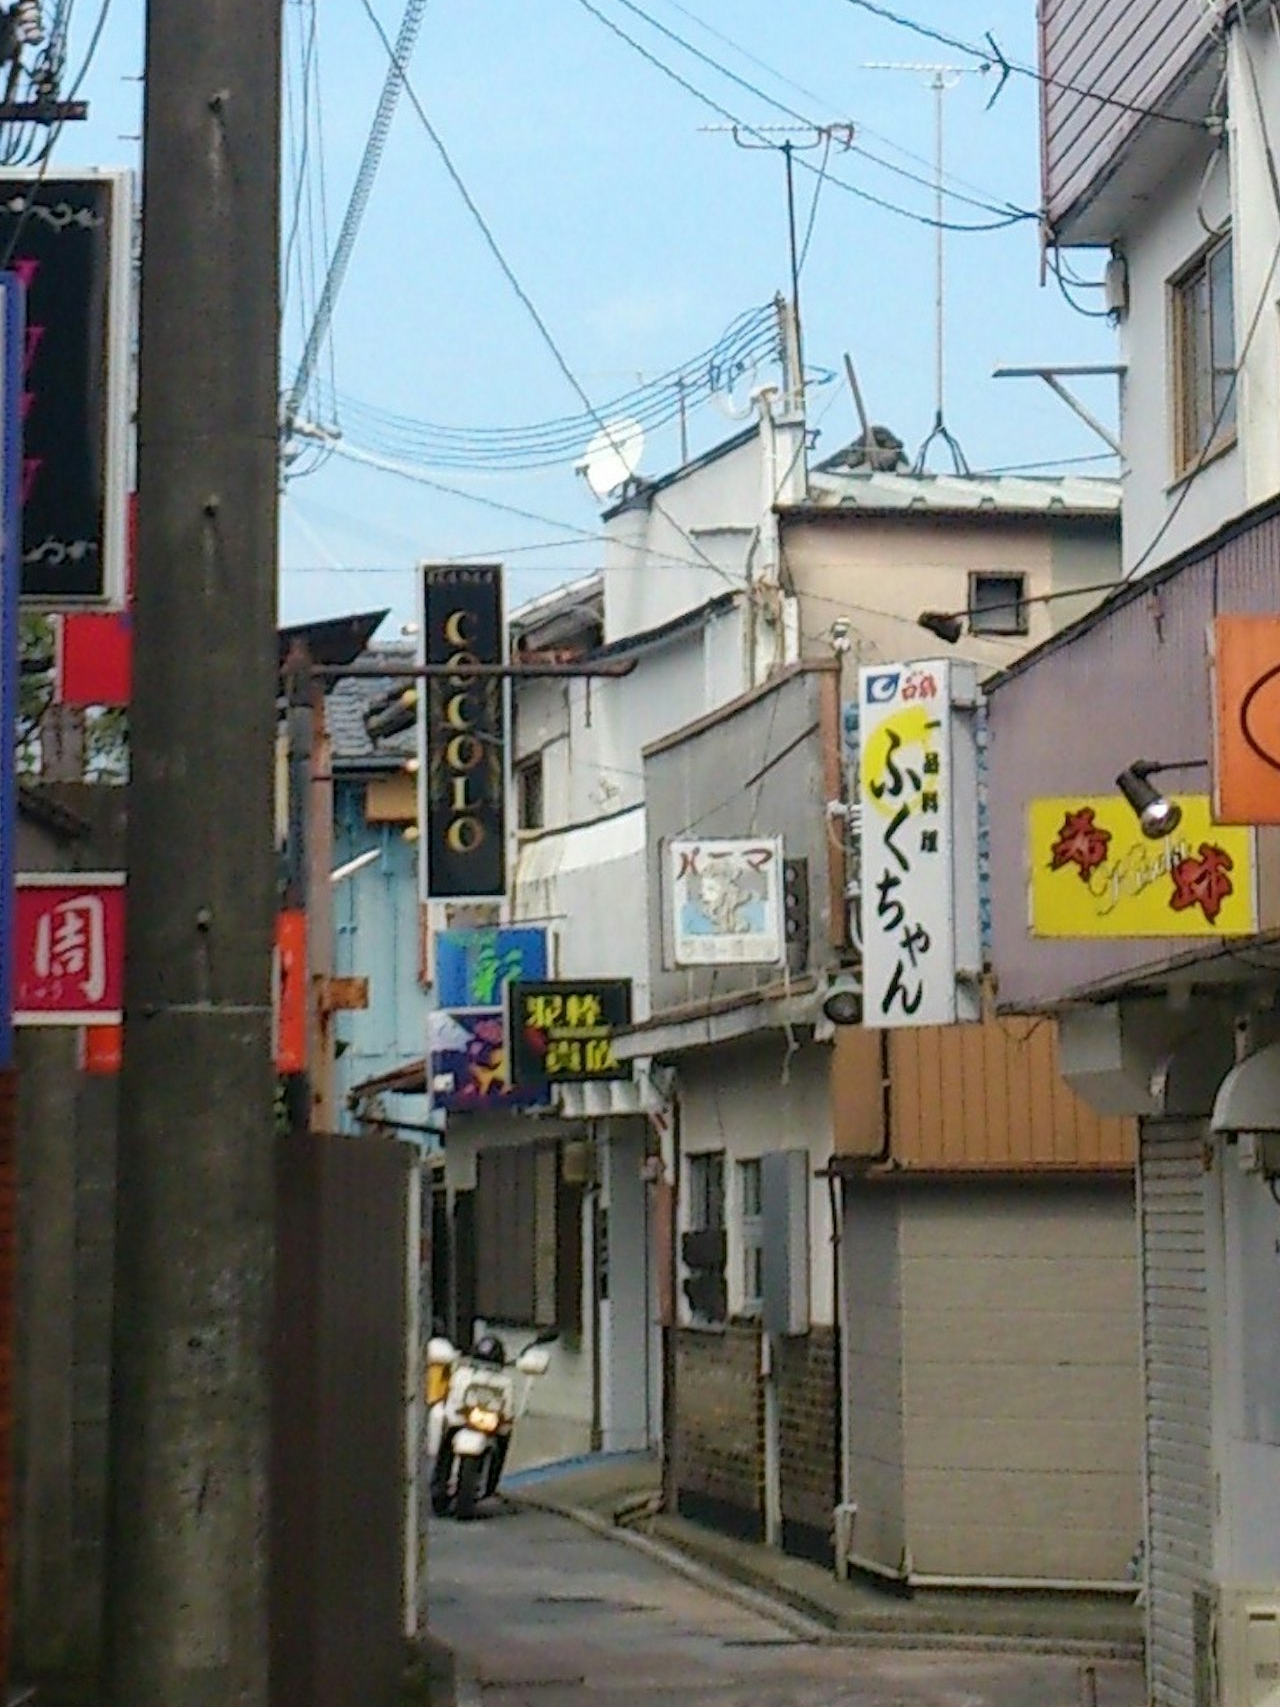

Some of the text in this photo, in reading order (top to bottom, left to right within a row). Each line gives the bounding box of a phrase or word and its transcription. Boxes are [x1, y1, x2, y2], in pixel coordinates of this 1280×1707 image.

[443, 609, 484, 854] COCOLO
[34, 892, 108, 1004] 周
[676, 846, 773, 880] パーマ
[869, 727, 931, 1016] ふくちゃん
